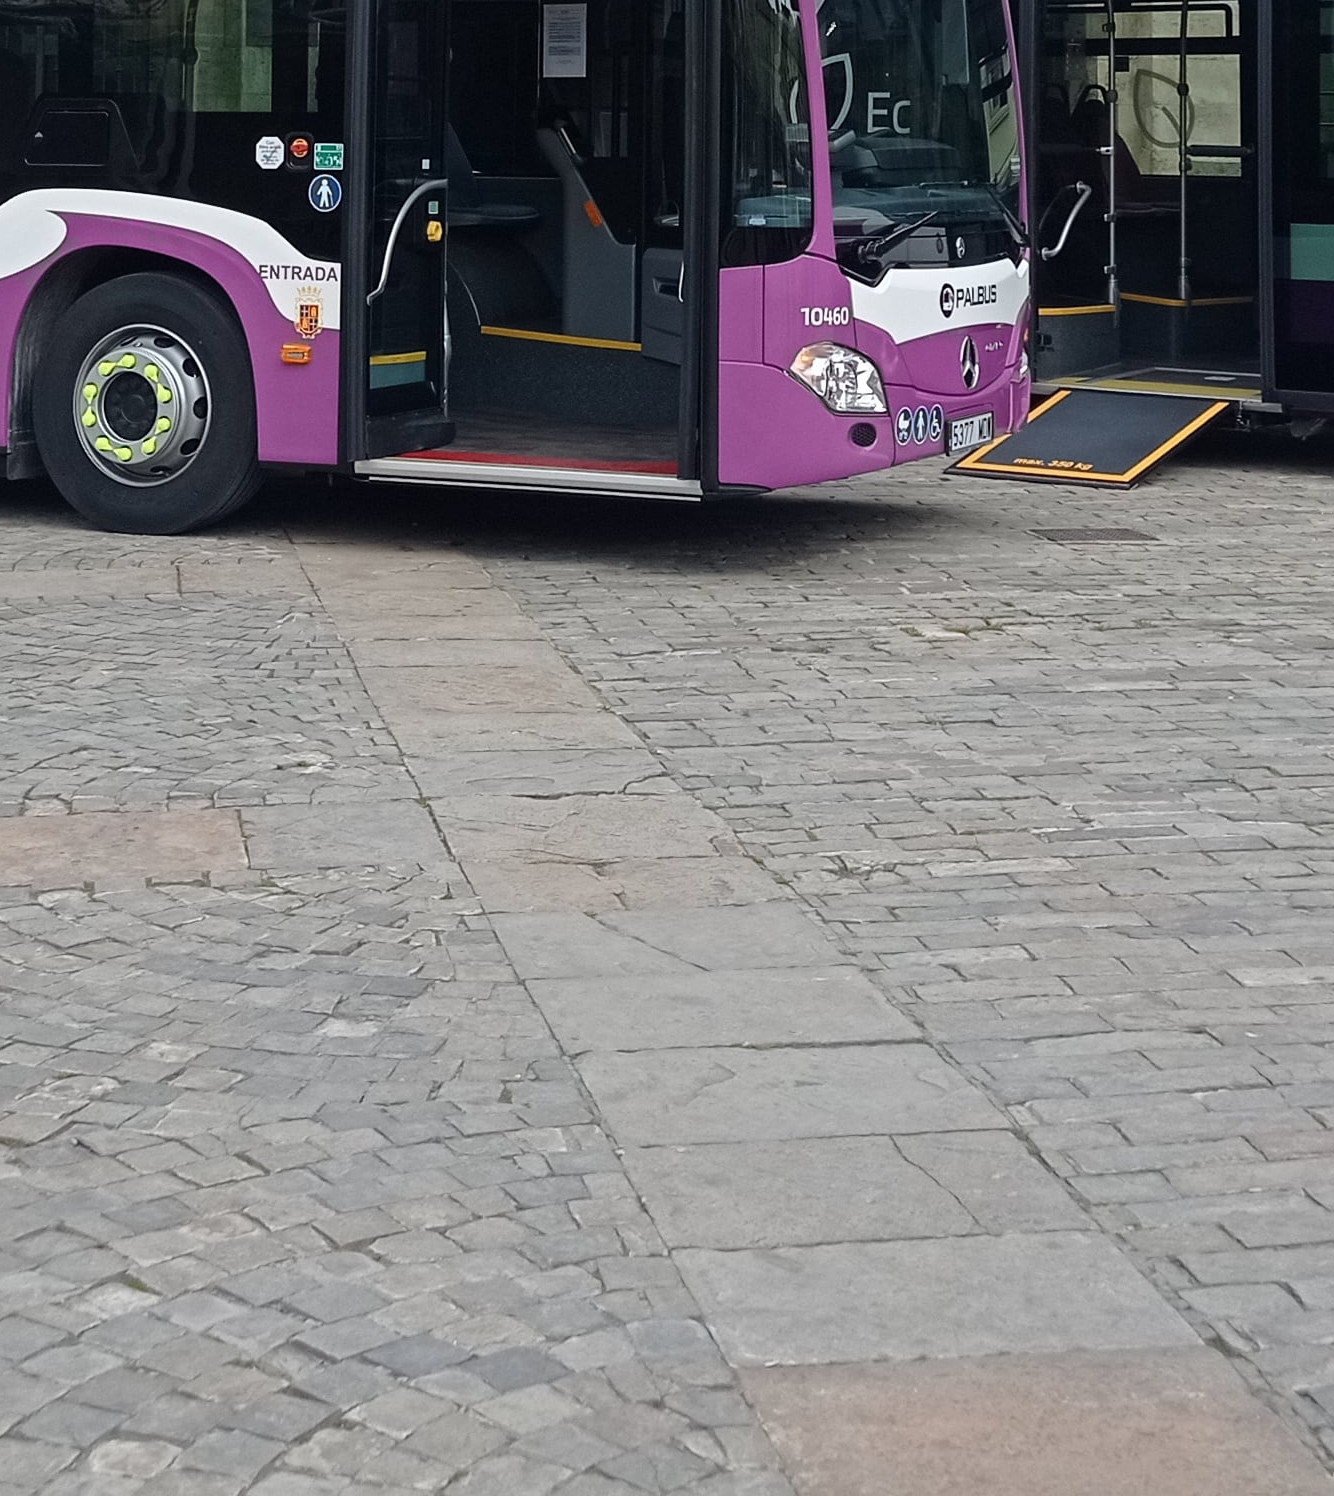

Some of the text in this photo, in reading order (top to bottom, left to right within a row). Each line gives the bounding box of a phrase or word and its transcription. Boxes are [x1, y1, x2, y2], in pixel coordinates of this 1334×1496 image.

[259, 264, 338, 282] ENTRADA
[956, 284, 997, 309] PALBUS
[800, 306, 849, 326] 10460
